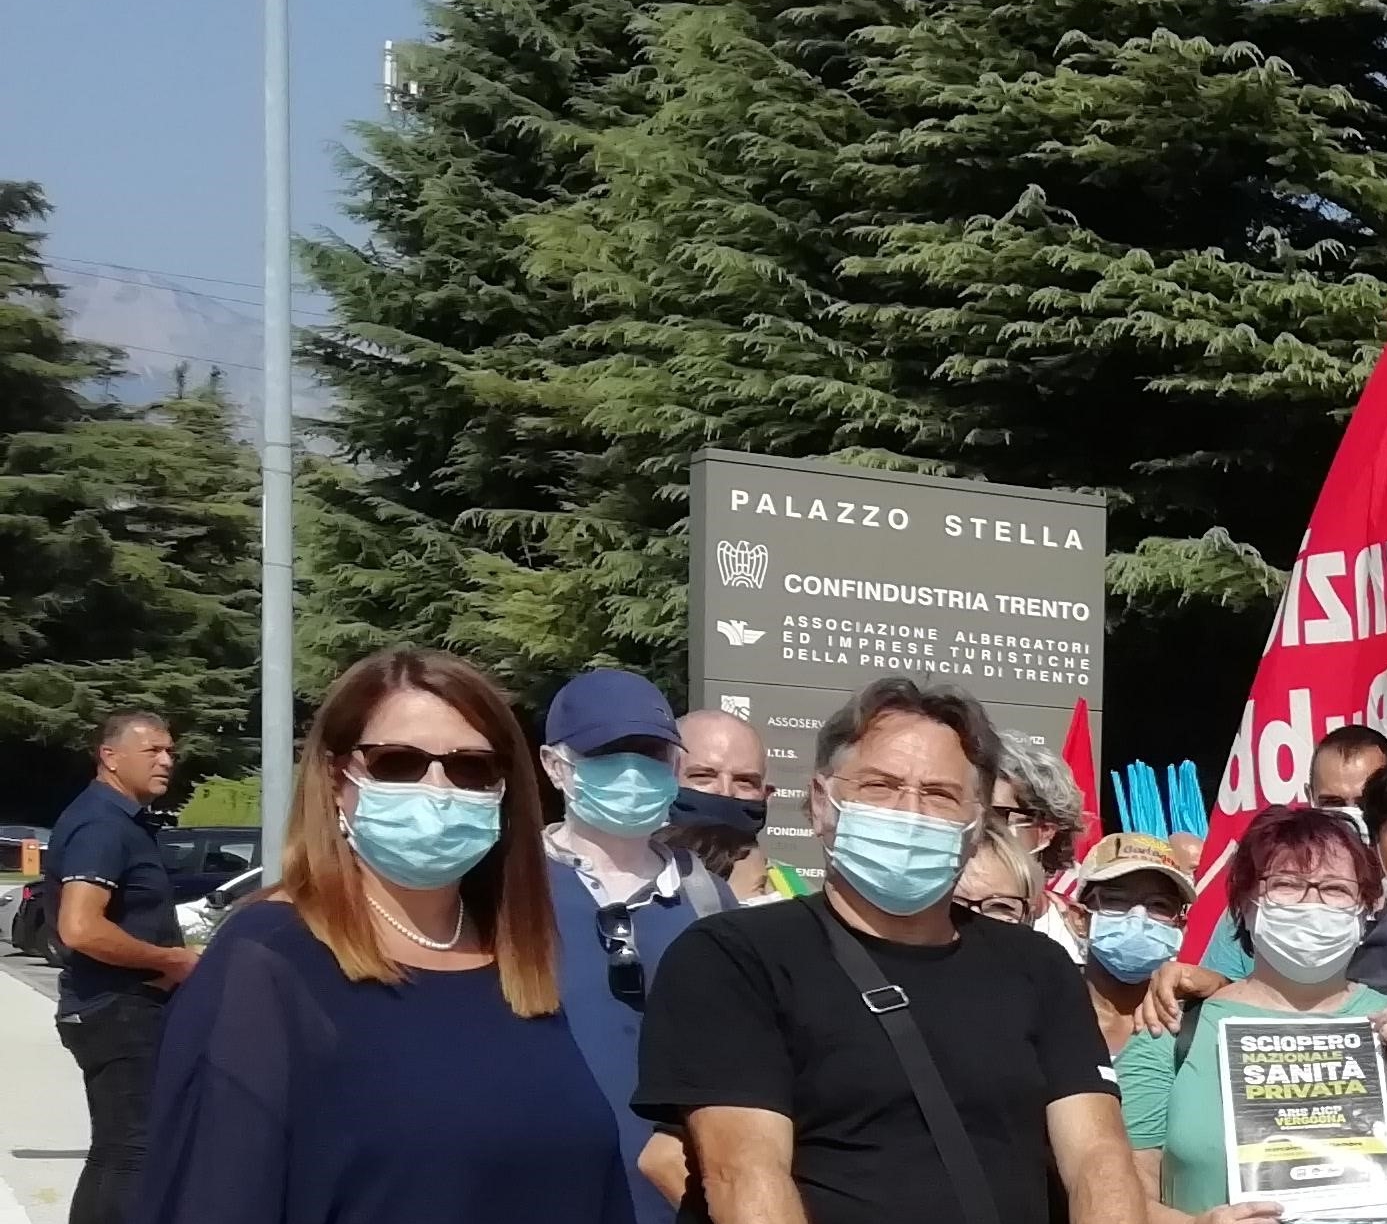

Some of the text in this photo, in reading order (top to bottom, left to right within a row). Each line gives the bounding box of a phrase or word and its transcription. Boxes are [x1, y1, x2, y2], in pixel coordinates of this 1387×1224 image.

[731, 489, 1084, 551] PALAZZO STELLA
[784, 573, 1090, 621] CONFINDUSTRIA TRENTO
[783, 615, 1090, 655] ASSOCIAZIONE ALBERGATORI
[783, 631, 1091, 670] ED IMPRESE TURISTICHE
[783, 647, 1089, 686] DELLA PROVINCIA DI TRENTO
[1240, 1034, 1361, 1052] SCIOPERO
[1242, 1051, 1344, 1063] NAZIONALE
[1243, 1057, 1367, 1085] SANITÀ
[1246, 1080, 1368, 1100] PRIVATA
